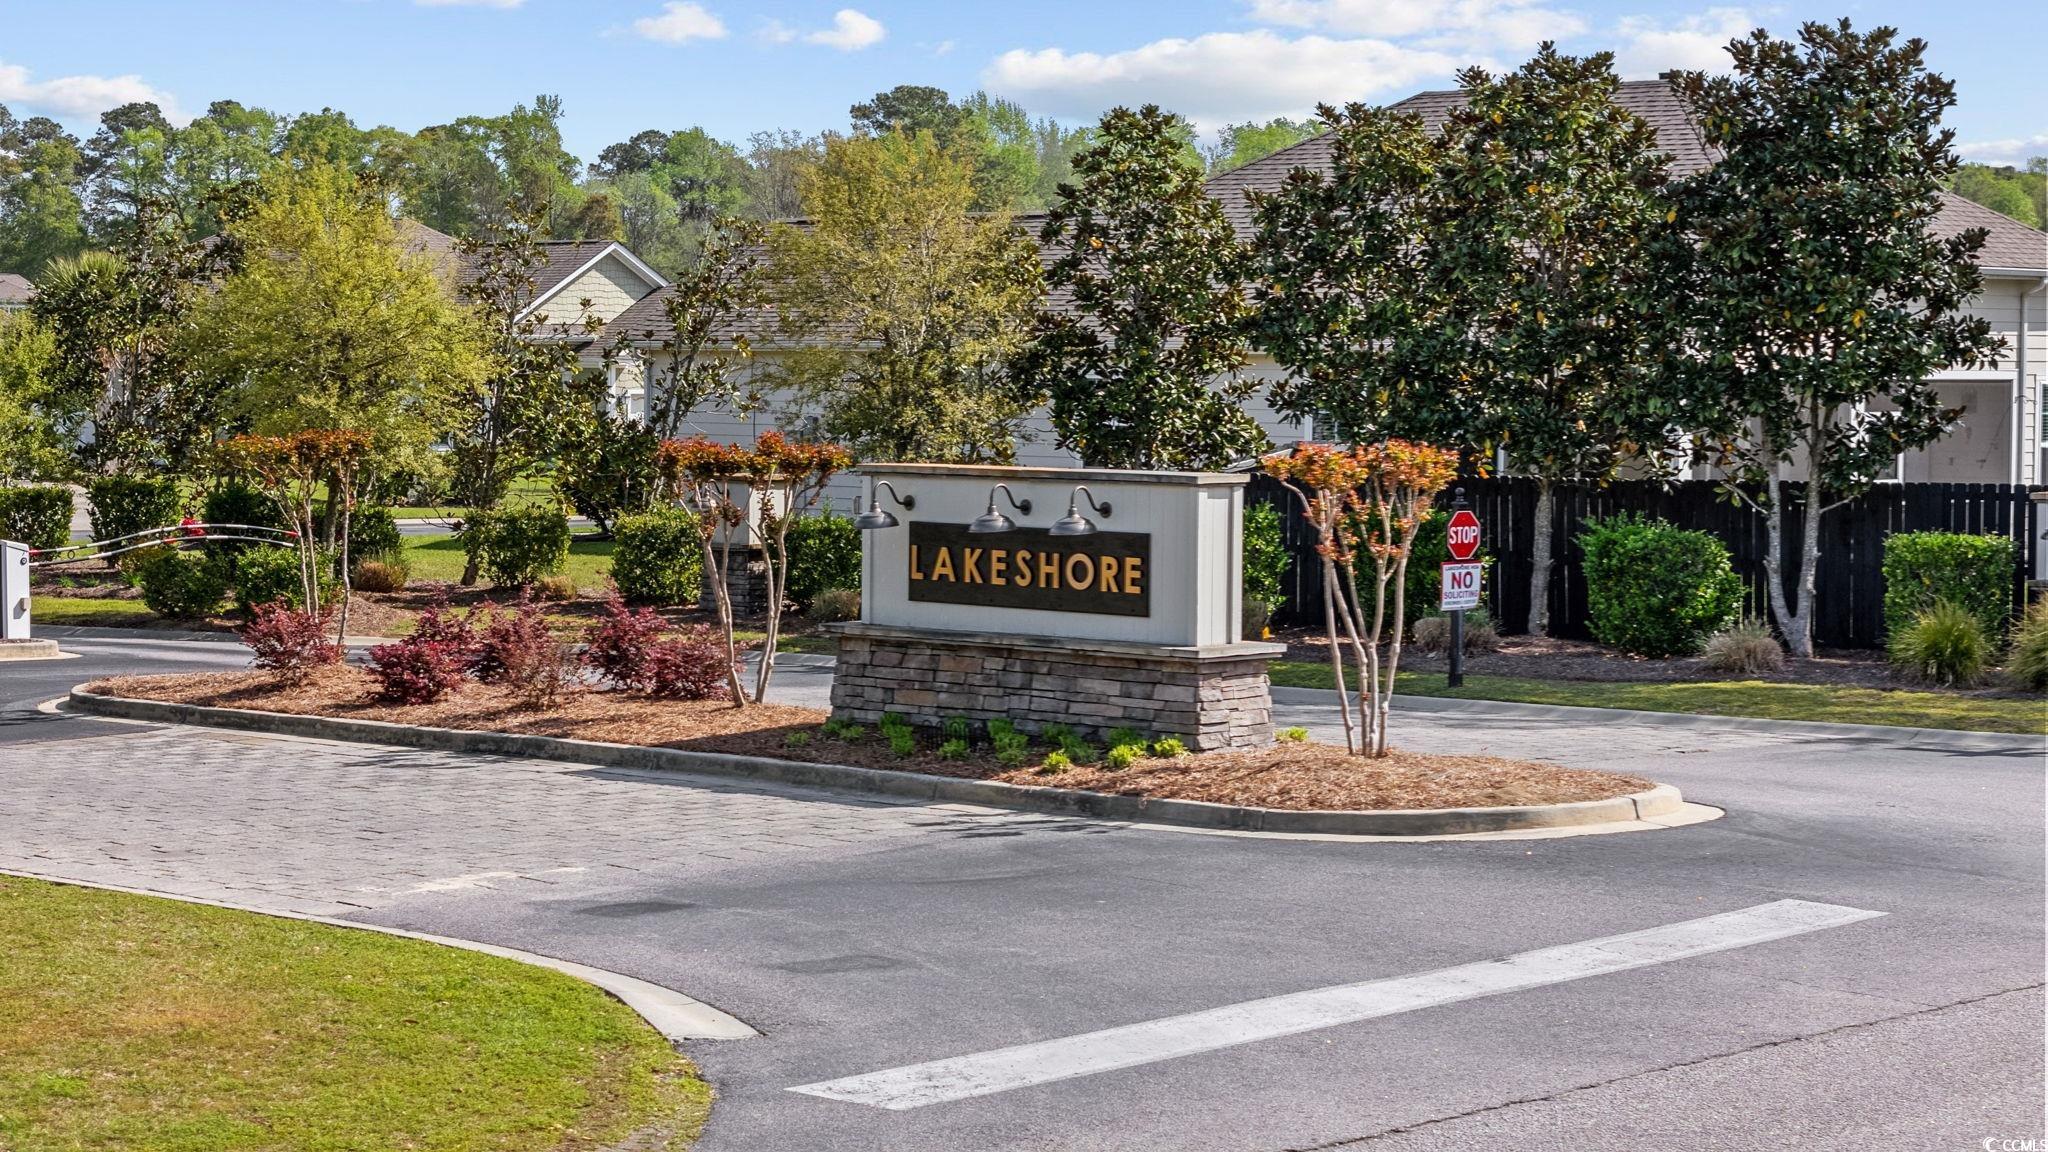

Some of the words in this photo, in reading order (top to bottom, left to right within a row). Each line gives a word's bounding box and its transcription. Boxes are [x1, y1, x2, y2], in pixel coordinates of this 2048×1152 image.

[1449, 526, 1478, 544] STOP
[910, 545, 1142, 594] LAKESHORE
[1451, 571, 1474, 590] NO
[1444, 590, 1478, 600] SOLICITING
